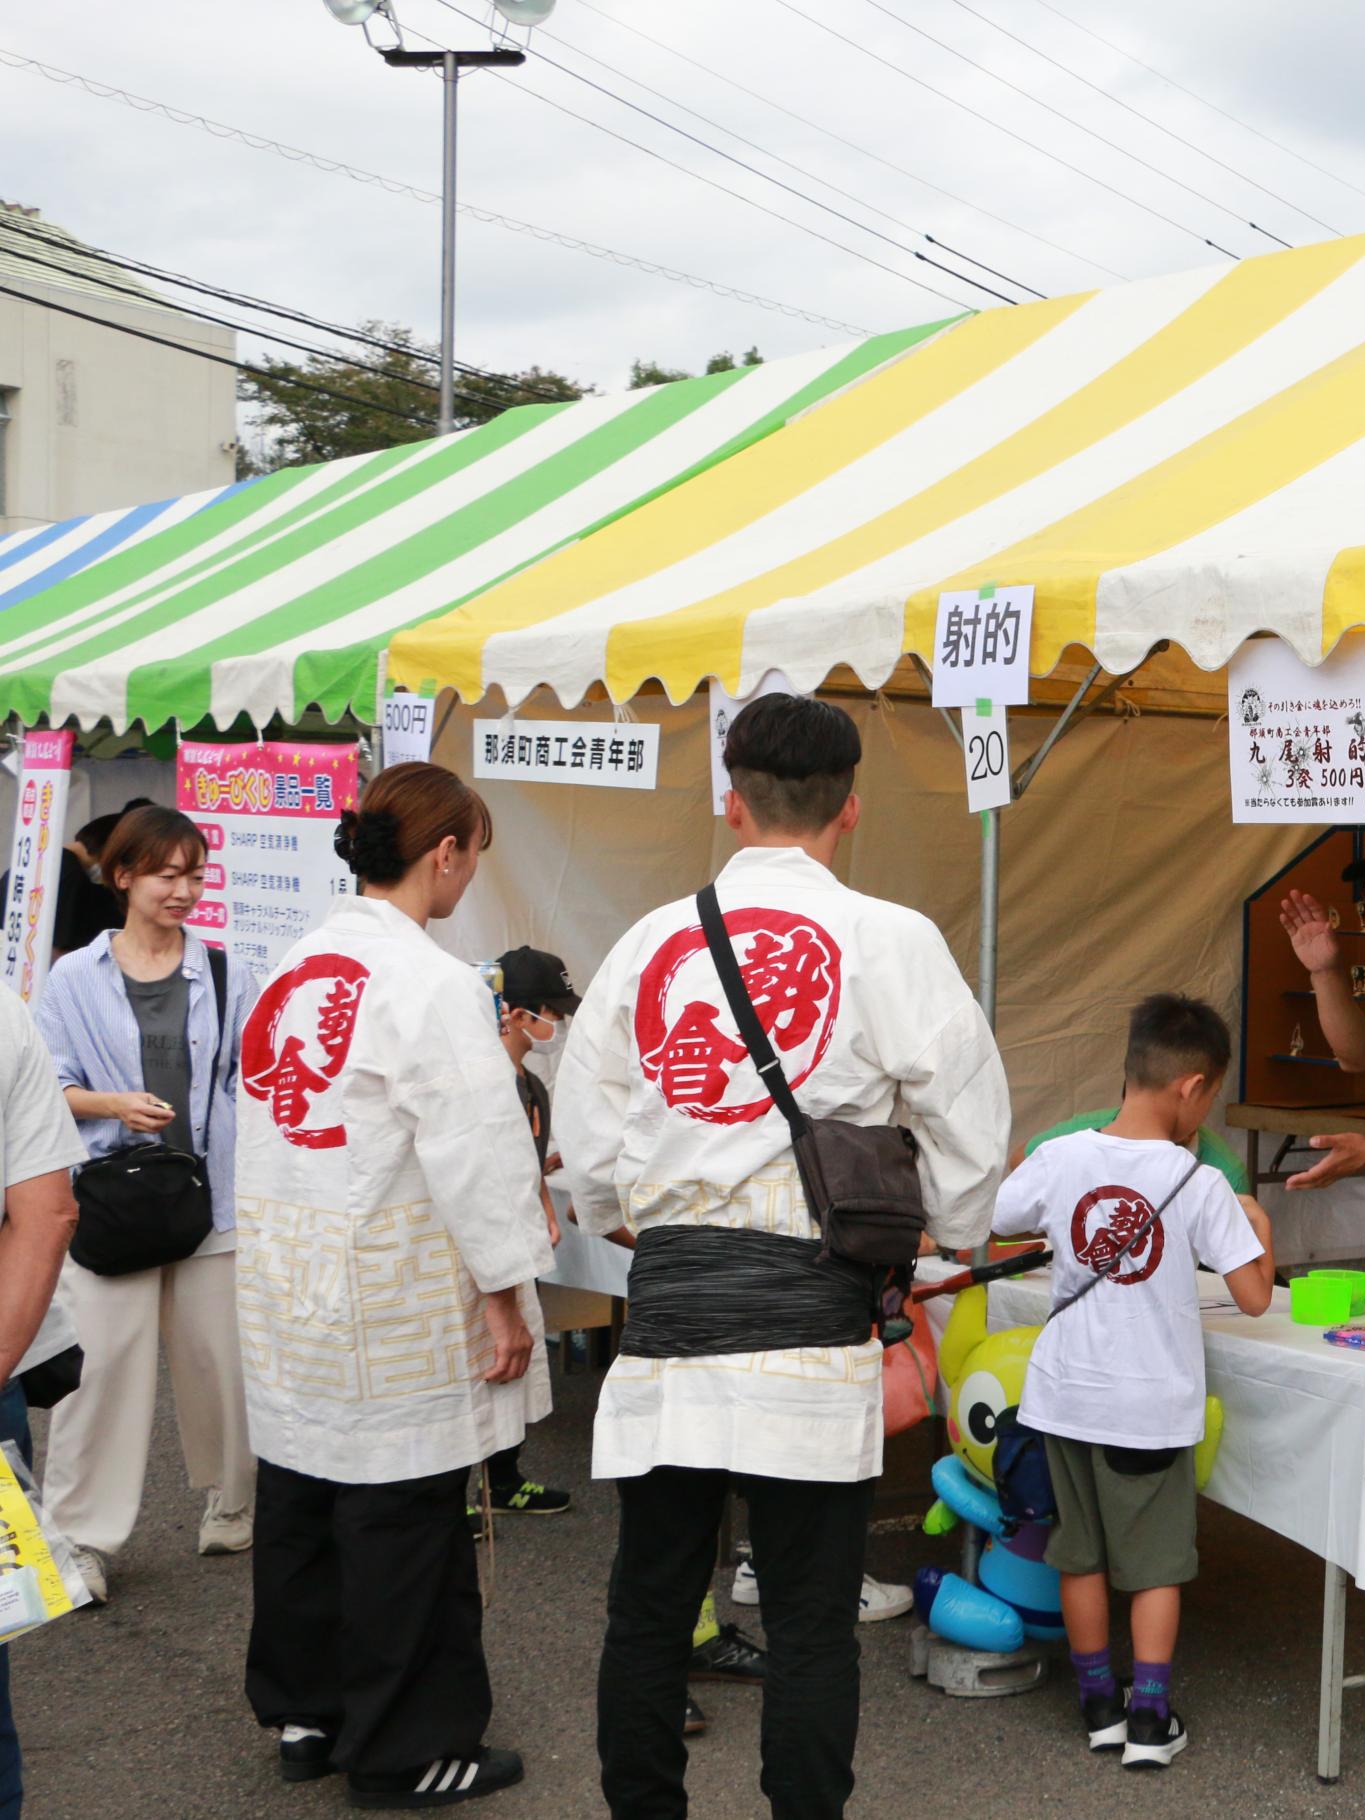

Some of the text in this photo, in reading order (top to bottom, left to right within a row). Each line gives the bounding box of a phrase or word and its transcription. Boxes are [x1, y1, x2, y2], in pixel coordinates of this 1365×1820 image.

[941, 601, 1022, 668] 射的
[385, 703, 428, 734] 500円
[1250, 725, 1331, 738] 那須町商工会青年部
[485, 733, 645, 772] 那須町商工会青年部
[969, 730, 1004, 781] 20
[1321, 767, 1365, 788] 500円
